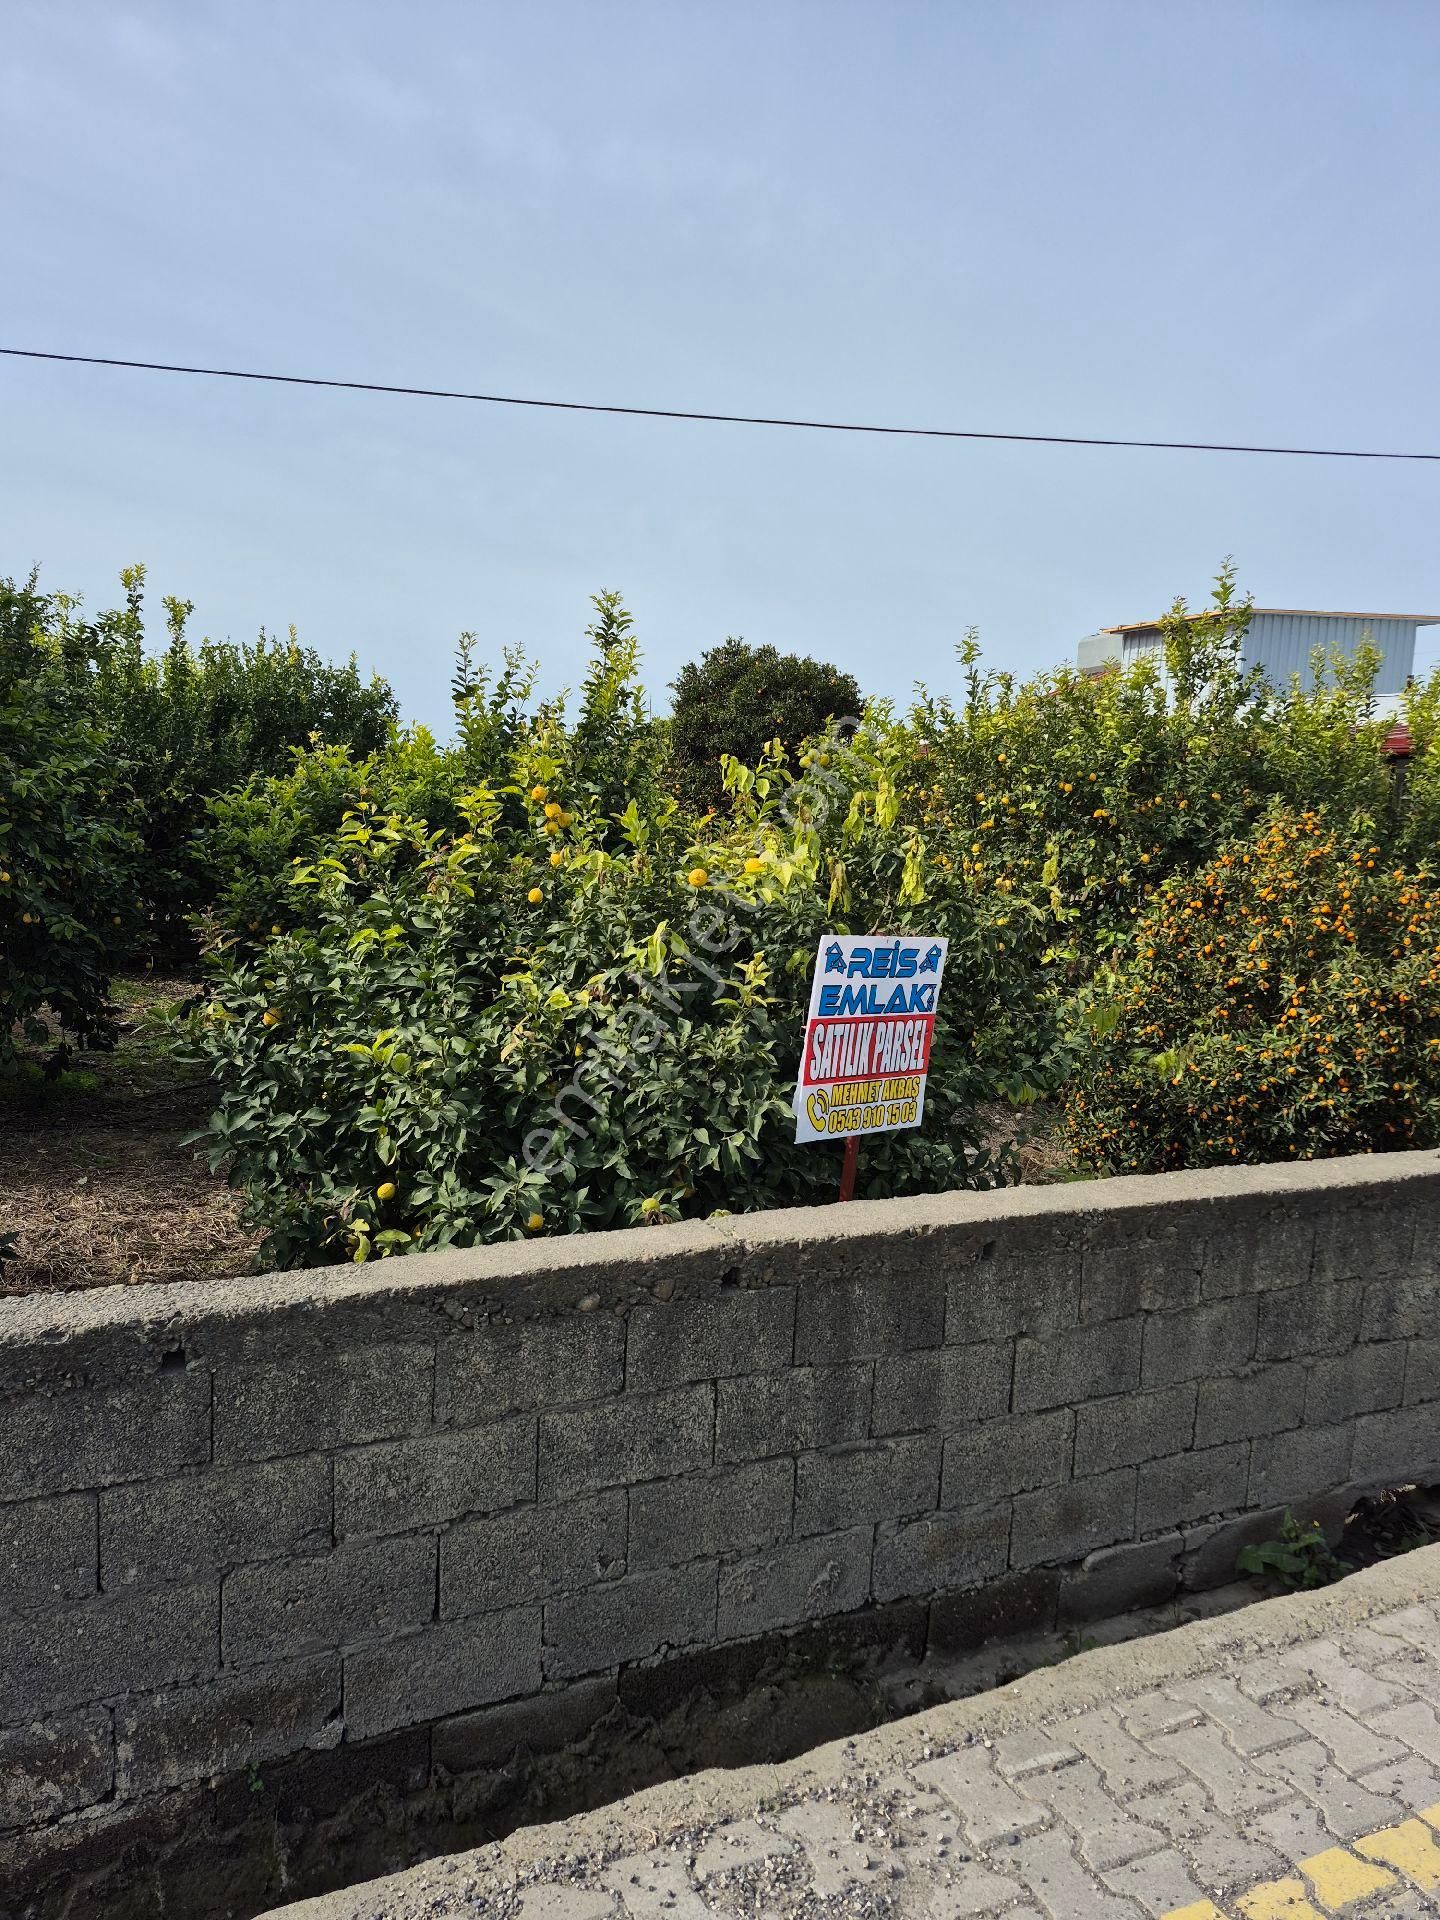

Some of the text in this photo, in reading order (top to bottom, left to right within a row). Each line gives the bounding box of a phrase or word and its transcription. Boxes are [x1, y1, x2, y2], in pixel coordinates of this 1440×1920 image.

[847, 940, 920, 978] REİS
[818, 984, 930, 1016] EMLAK
[809, 1019, 928, 1081] SATILIK PARSEL
[830, 1076, 920, 1107] MEHMET AKBAŞ
[828, 1100, 917, 1134] 0543 910 15 03
